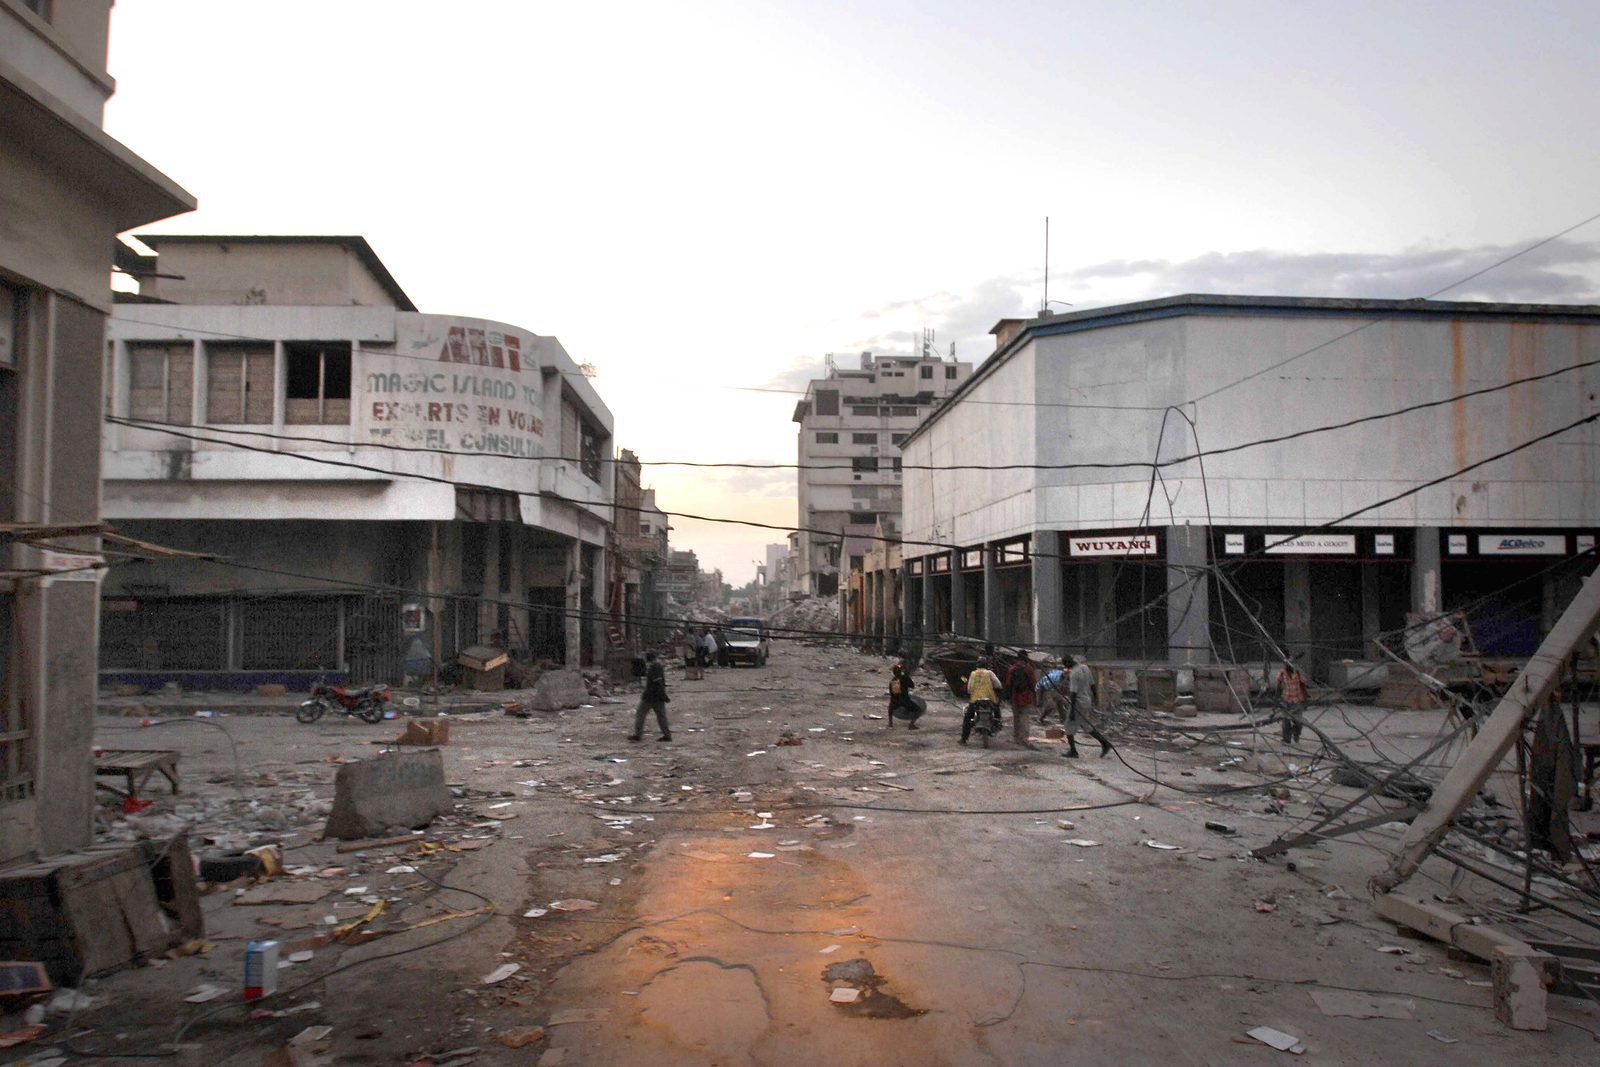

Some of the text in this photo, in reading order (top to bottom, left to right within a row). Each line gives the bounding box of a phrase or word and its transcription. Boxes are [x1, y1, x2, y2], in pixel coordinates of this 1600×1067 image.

[367, 372, 447, 393] MAGIC
[453, 374, 516, 400] ISLAND
[1075, 540, 1151, 552] WUYANG
[1498, 538, 1545, 549] ACDelco
